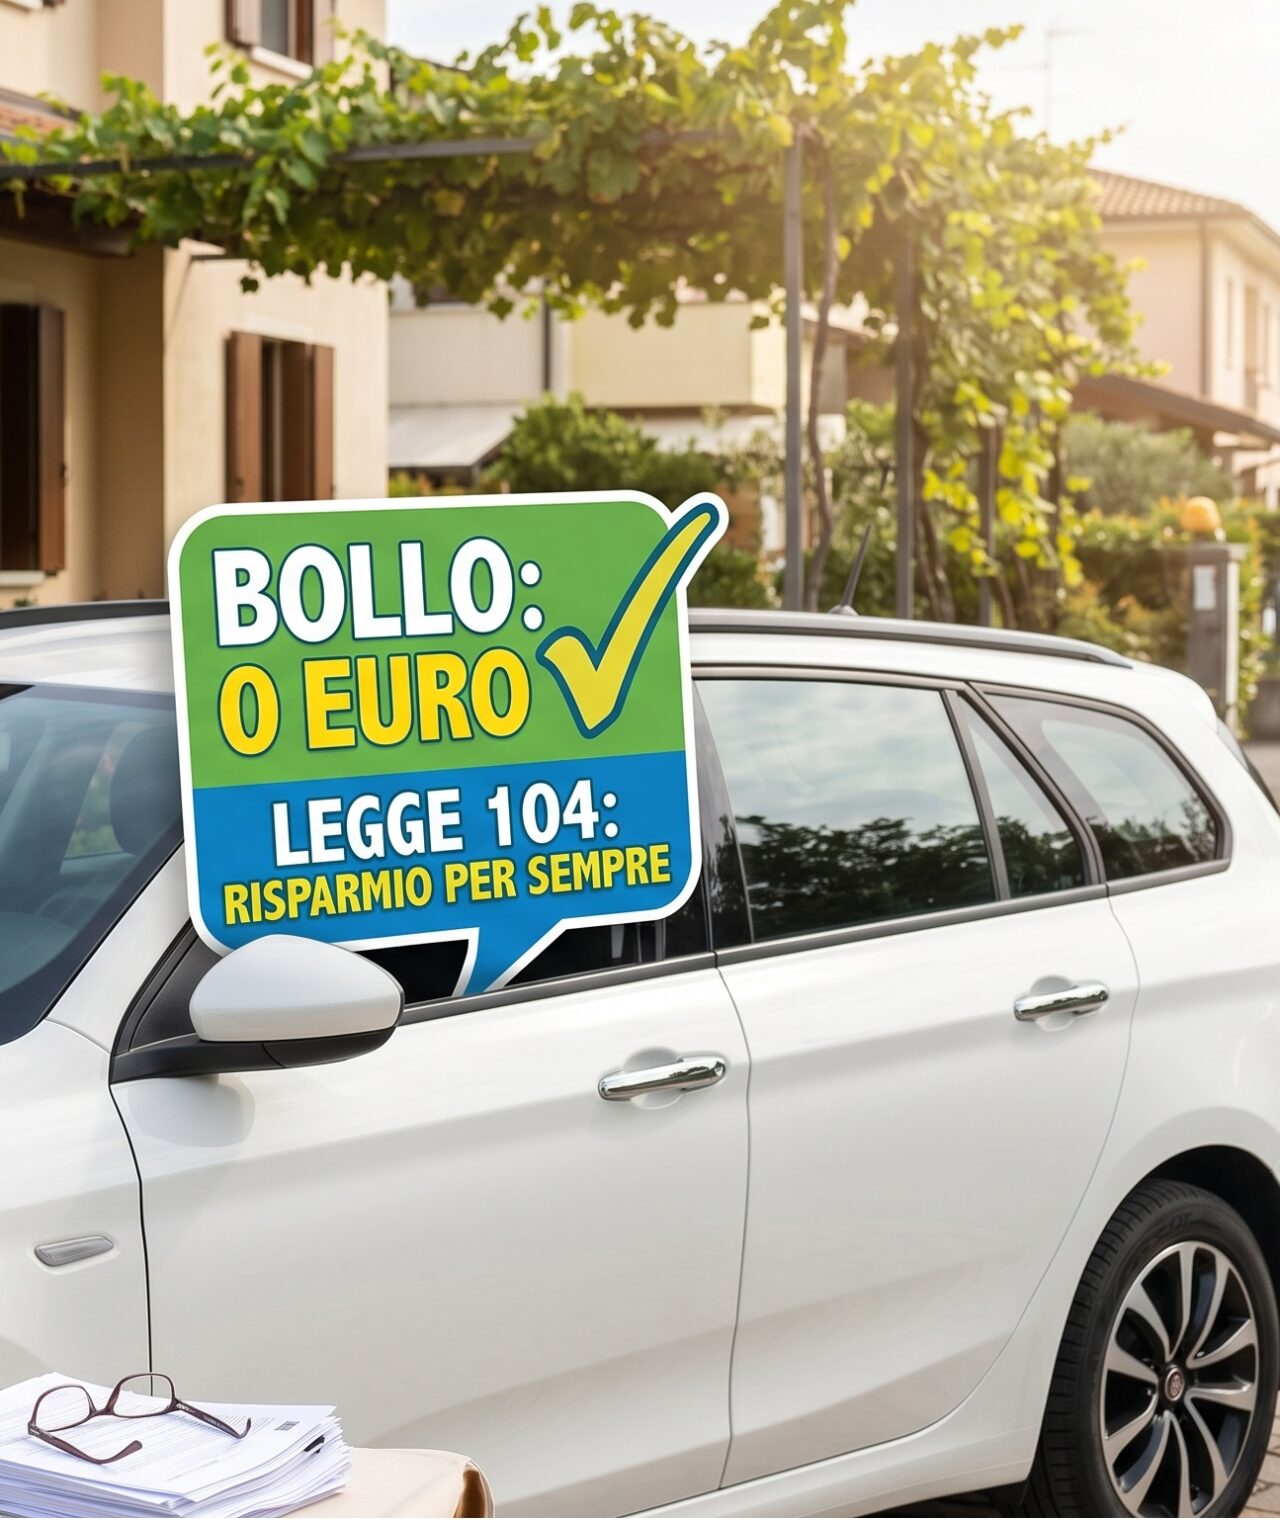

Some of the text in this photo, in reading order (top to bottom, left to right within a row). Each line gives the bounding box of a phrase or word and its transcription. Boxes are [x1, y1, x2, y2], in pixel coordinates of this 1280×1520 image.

[212, 536, 544, 647] BOLLO:
[303, 648, 531, 750] EURO
[272, 778, 619, 867] LEGGE 104:
[224, 844, 670, 925] RISPARMIO PER SEMPRE
